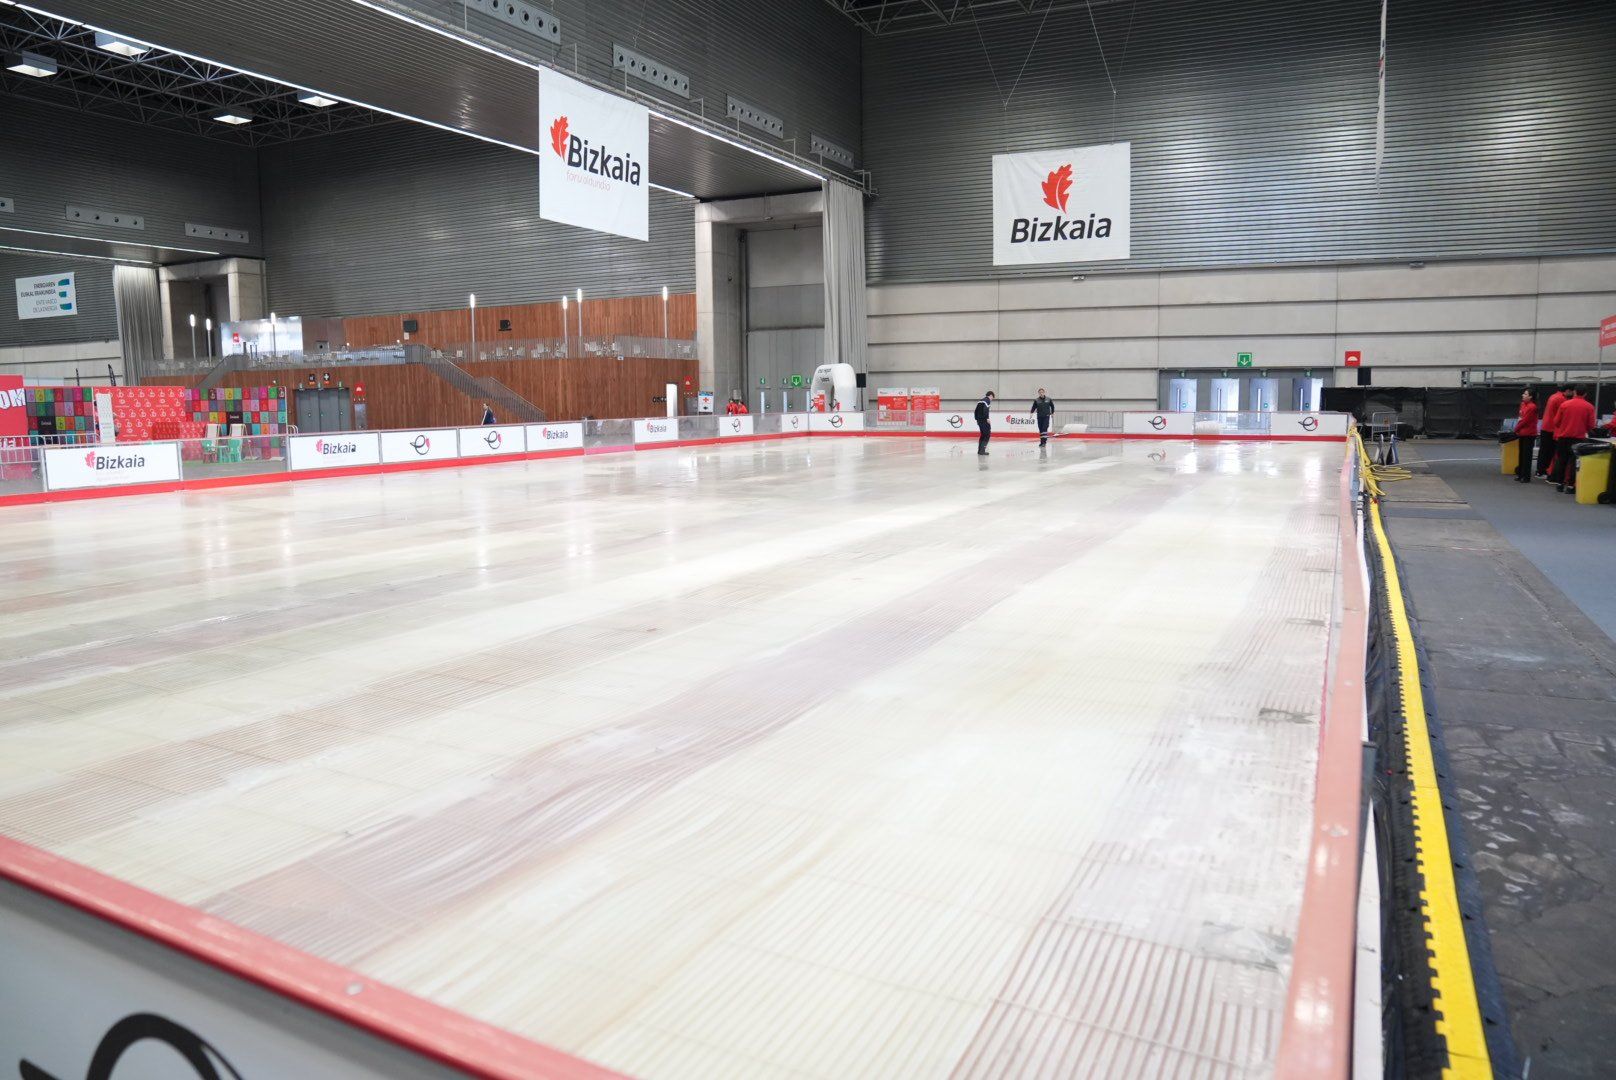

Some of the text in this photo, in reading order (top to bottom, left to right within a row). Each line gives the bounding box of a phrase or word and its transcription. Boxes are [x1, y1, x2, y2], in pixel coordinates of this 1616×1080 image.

[567, 134, 641, 186] Bizkaia
[1011, 213, 1112, 243] Bizkaia
[1010, 417, 1035, 425] Bizkaia
[547, 430, 569, 440] Bizkaia
[323, 442, 357, 455] Bizkaia
[96, 454, 145, 470] Bizkaia
